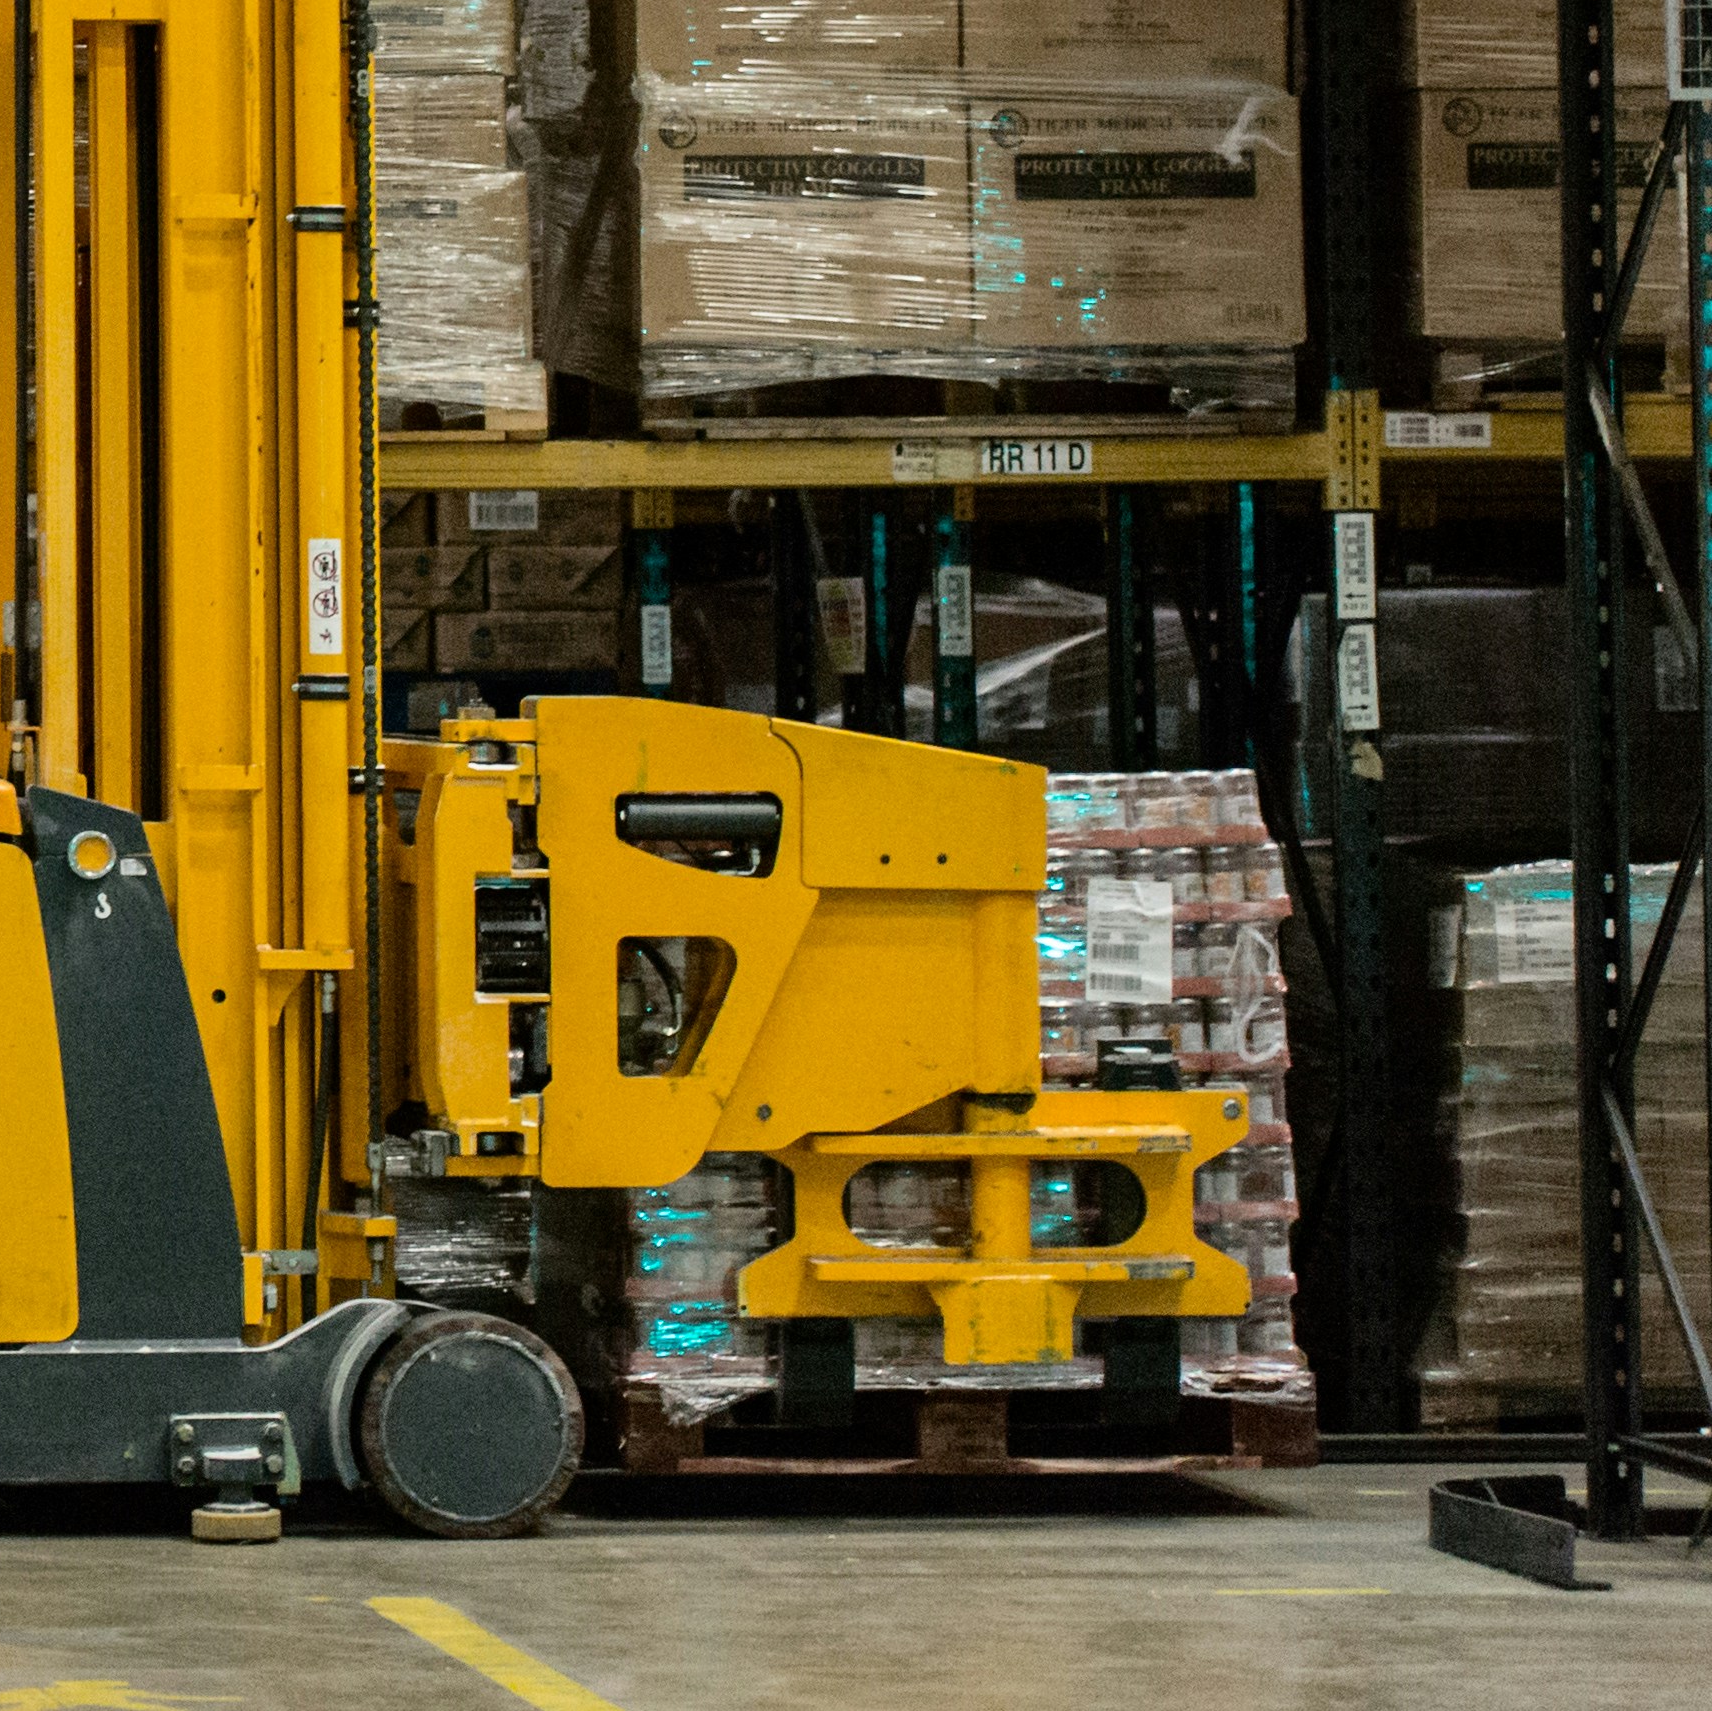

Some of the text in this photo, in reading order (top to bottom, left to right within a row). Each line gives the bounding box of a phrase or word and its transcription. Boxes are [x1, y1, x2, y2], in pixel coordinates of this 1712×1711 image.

[688, 159, 922, 177] PROTECTIVE GOGGLES
[1019, 159, 1146, 176] PROTECTIVE
[1100, 178, 1170, 194] FRAME
[1033, 443, 1057, 472] 11
[1068, 442, 1086, 471] D
